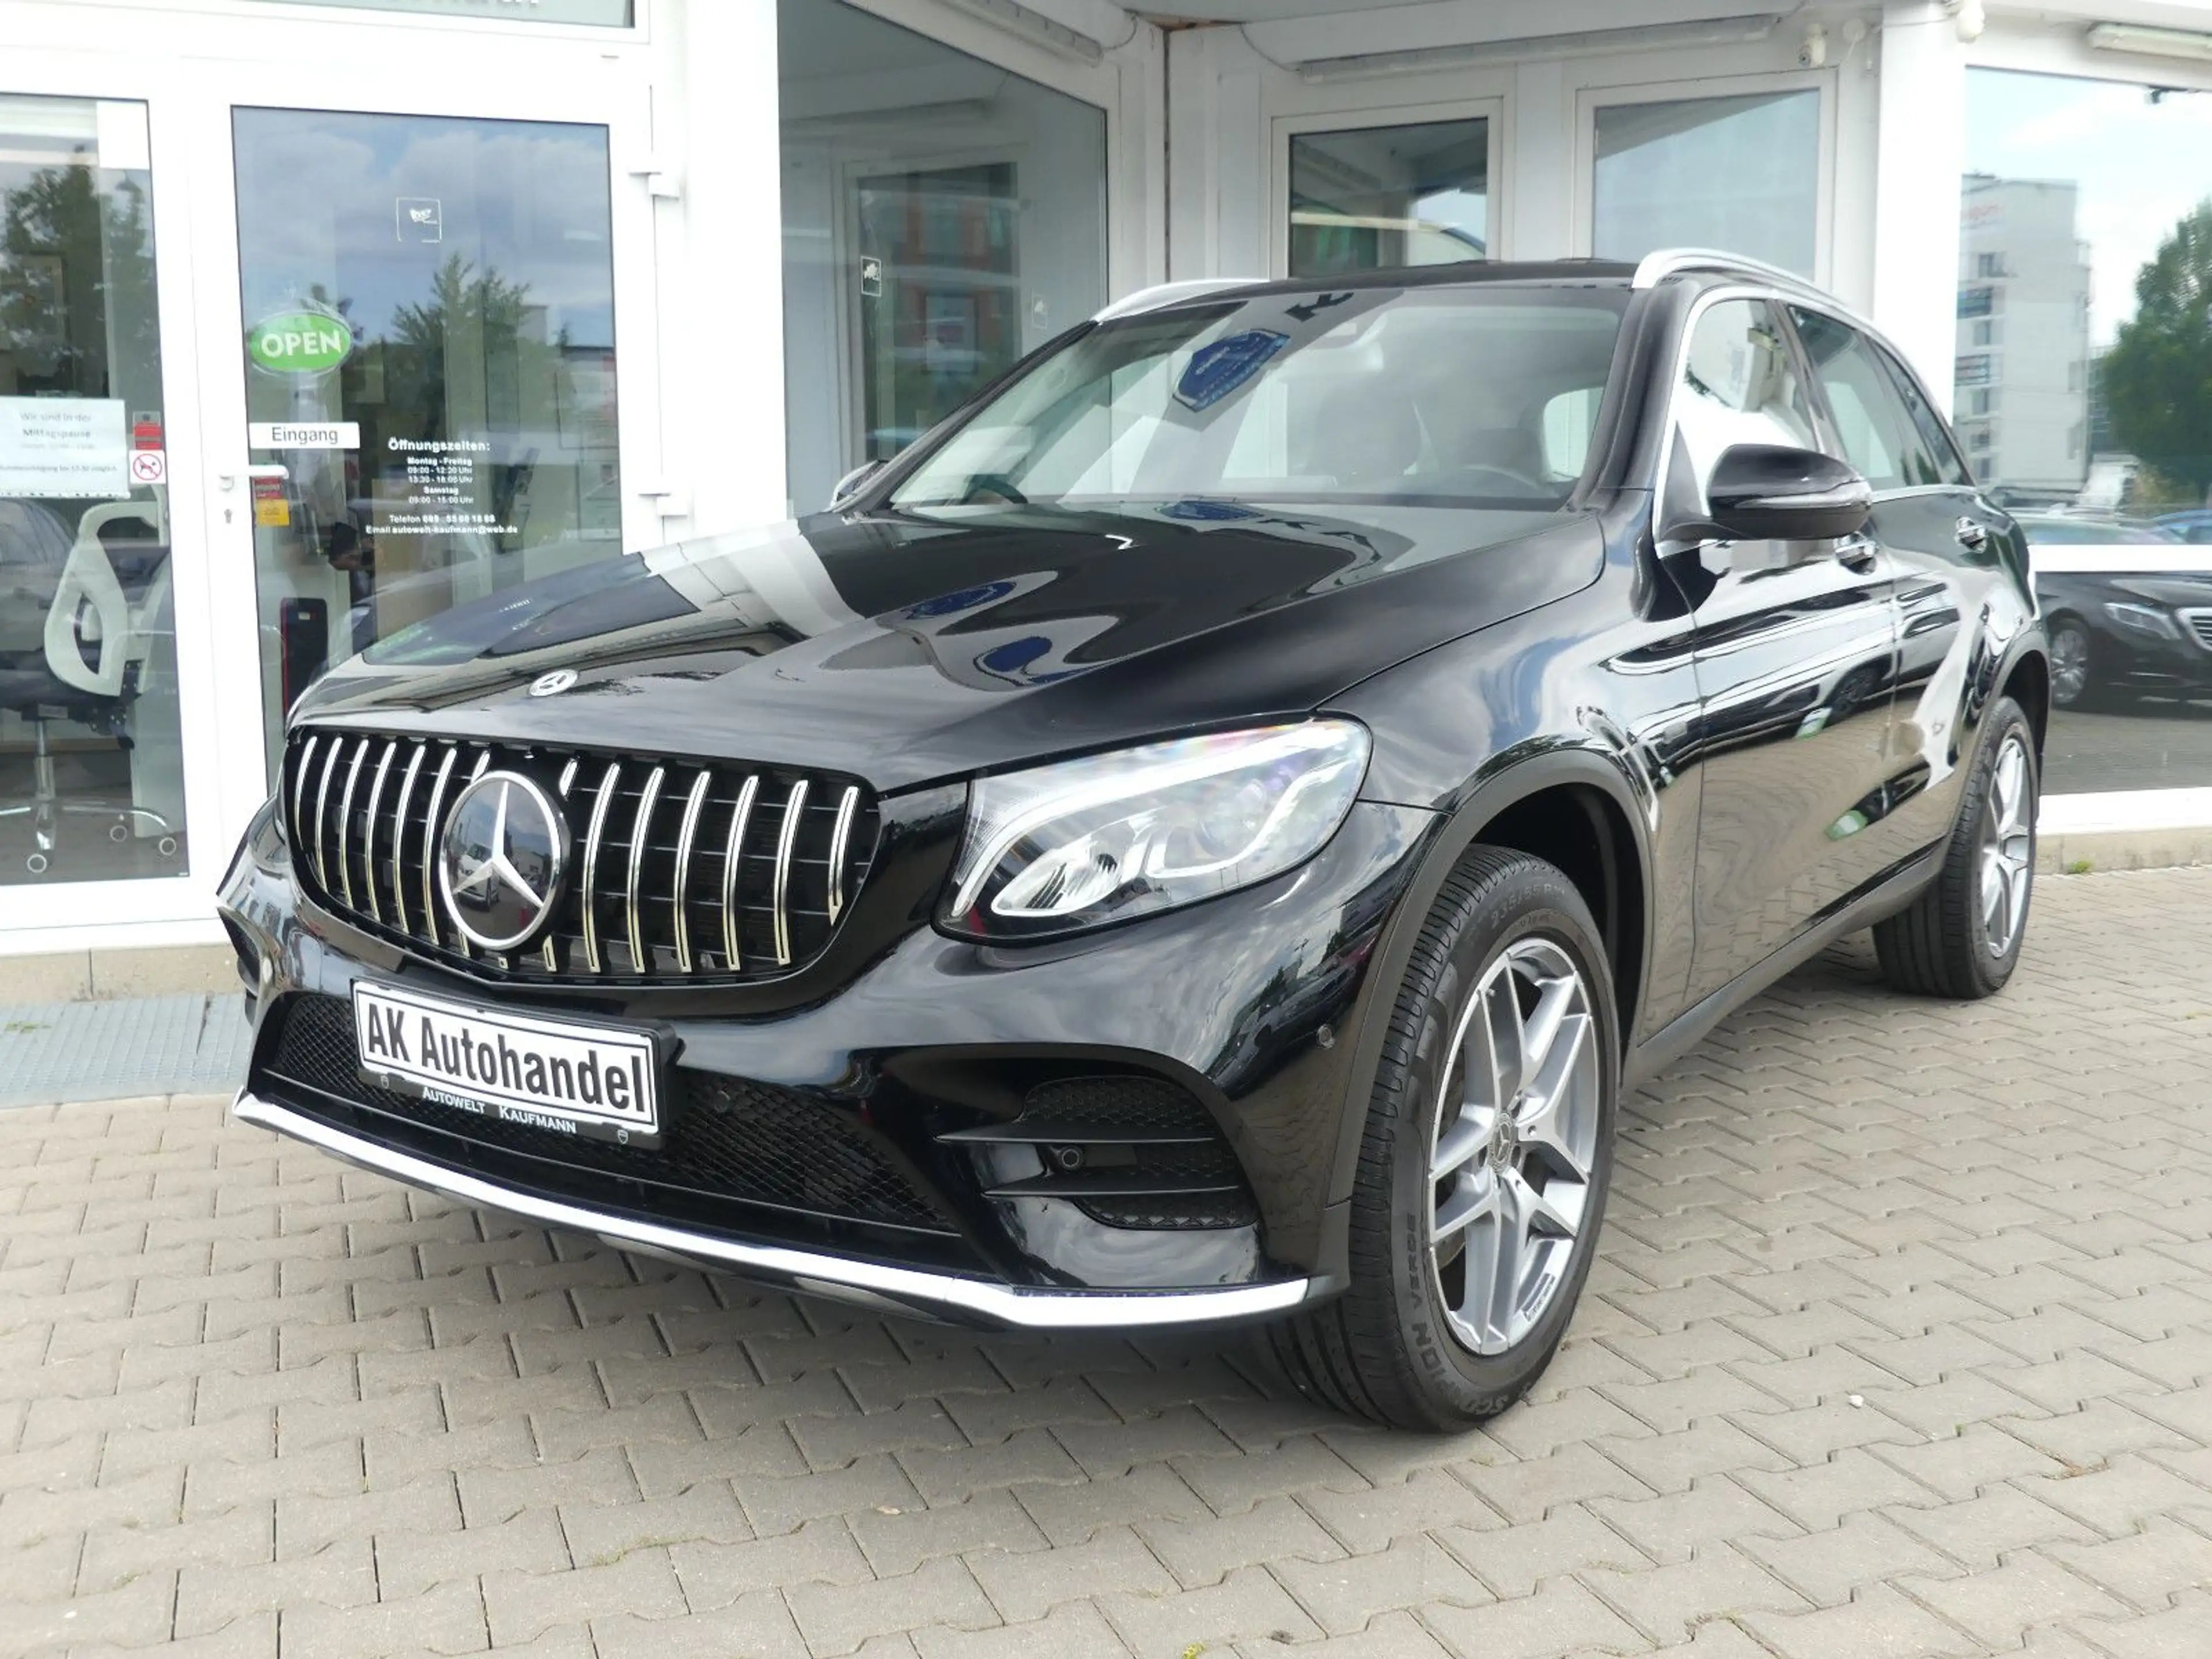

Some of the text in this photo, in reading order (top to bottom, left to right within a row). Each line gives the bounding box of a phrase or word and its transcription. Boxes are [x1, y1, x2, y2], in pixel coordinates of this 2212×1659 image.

[261, 330, 342, 358] OPEN
[272, 427, 338, 444] Eingang
[388, 437, 490, 453] Öffnungszeiten:
[407, 456, 438, 466] Montag
[443, 457, 472, 466] Freitag
[423, 486, 459, 495] Samstag
[389, 514, 421, 523] Telefon
[368, 1002, 646, 1112] AK Autohandel
[422, 1086, 577, 1135] AUTOWELT KAUFMANN
